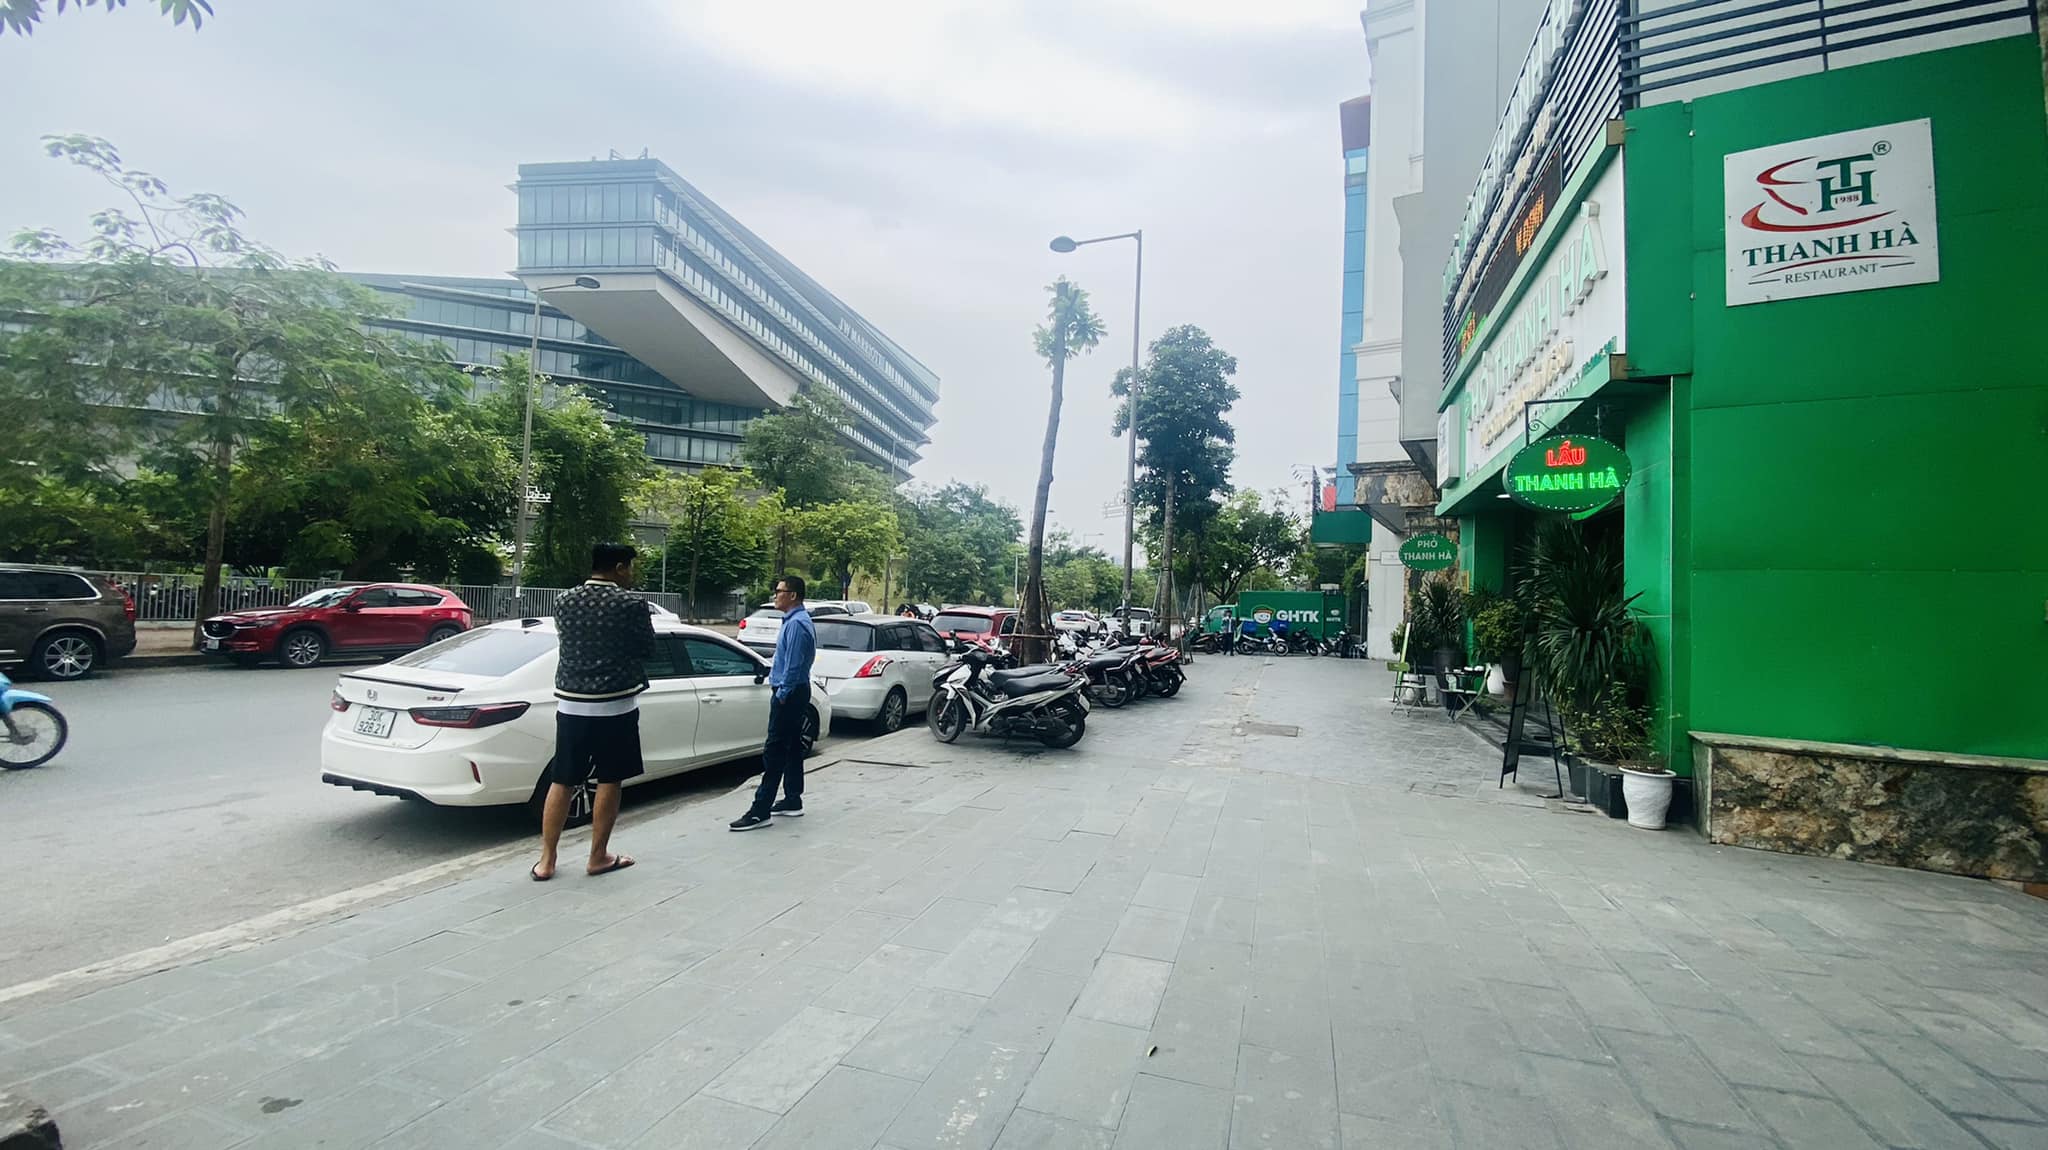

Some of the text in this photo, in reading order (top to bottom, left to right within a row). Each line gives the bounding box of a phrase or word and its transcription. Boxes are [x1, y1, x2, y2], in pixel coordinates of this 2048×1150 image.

[1742, 221, 1920, 267] THANH HÀ
[1785, 262, 1879, 284] RESTAURANT
[1495, 276, 1555, 394] THANH
[1559, 201, 1606, 316] HÀ
[1515, 467, 1619, 492] THANH HÀ
[1403, 549, 1452, 561] THANH HÀ
[1276, 610, 1319, 622] GHTK
